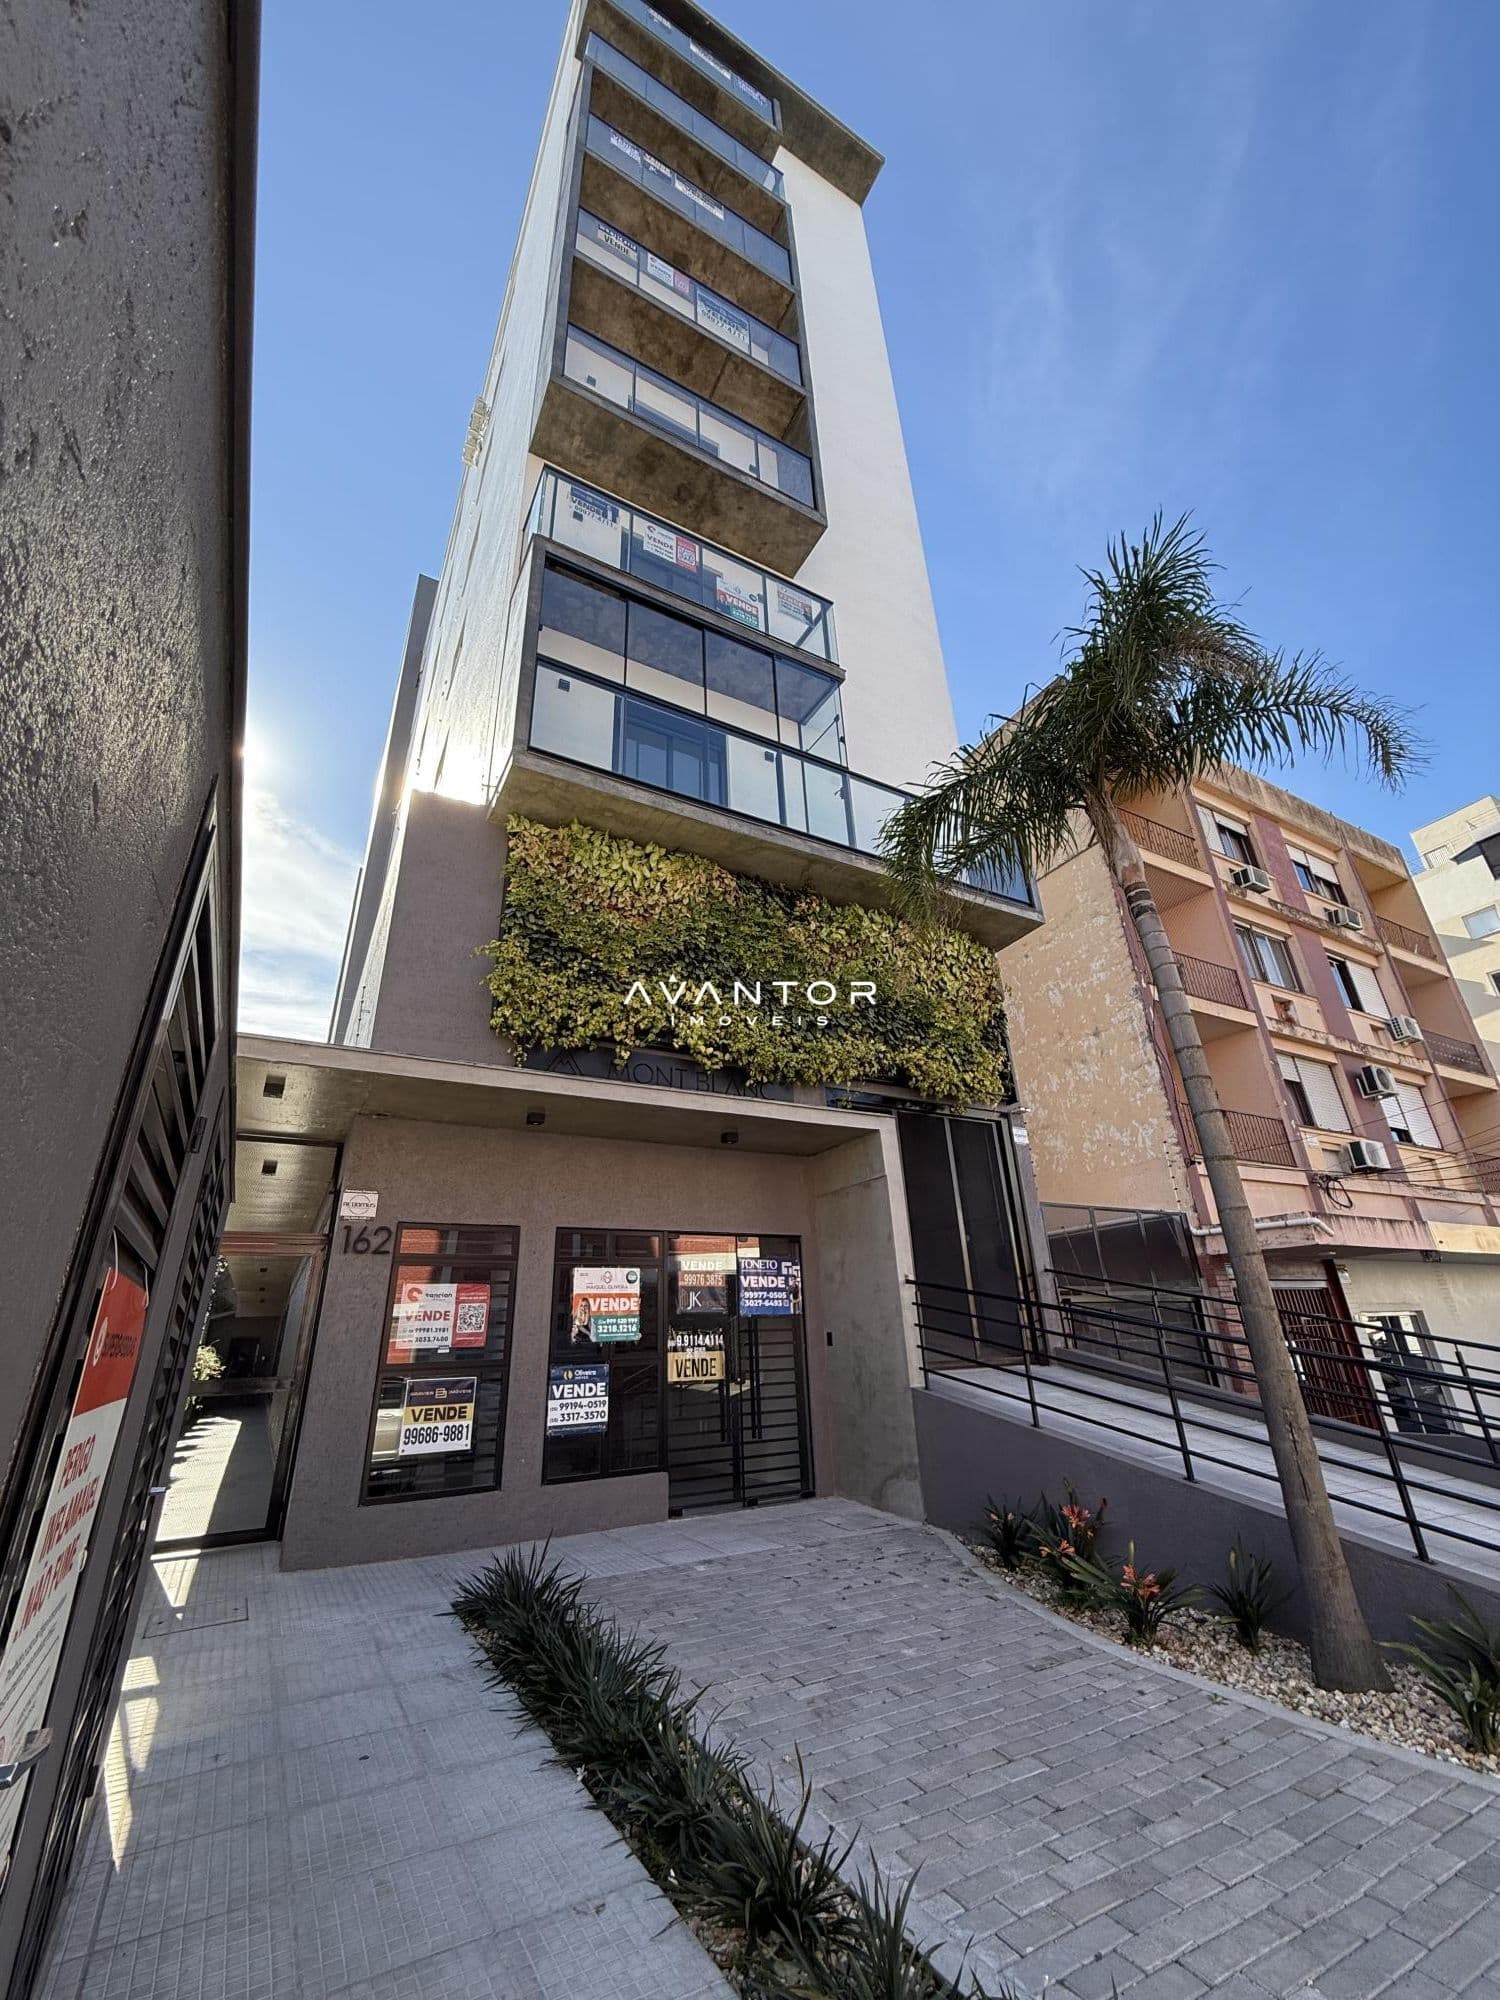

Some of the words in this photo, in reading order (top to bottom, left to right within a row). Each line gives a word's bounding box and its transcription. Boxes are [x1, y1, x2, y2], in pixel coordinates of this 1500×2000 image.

[571, 496, 602, 517] VENDE
[646, 534, 674, 551] VENDE
[725, 593, 759, 616] VENDE
[607, 1059, 688, 1089] MONT
[343, 1225, 392, 1255] 162
[682, 1260, 723, 1271] VENDE
[741, 1259, 778, 1270] TONETO
[683, 1273, 705, 1286] 99976
[706, 1273, 723, 1286] 3875
[740, 1275, 786, 1288] VENDE
[589, 1298, 640, 1312] VENDE
[687, 1290, 702, 1311] JK
[405, 1310, 451, 1322] VENDE
[676, 1334, 724, 1347] 9.9114.4114
[675, 1357, 717, 1379] VENDE
[552, 1382, 607, 1399] VENDE
[411, 1405, 468, 1423] VENDE
[559, 1400, 607, 1412] 99194-0519
[559, 1410, 607, 1423] 3317-3570
[403, 1423, 471, 1445] 99686-9881
[58, 1433, 96, 1493] PERIGO
[53, 1533, 81, 1591] FUME
